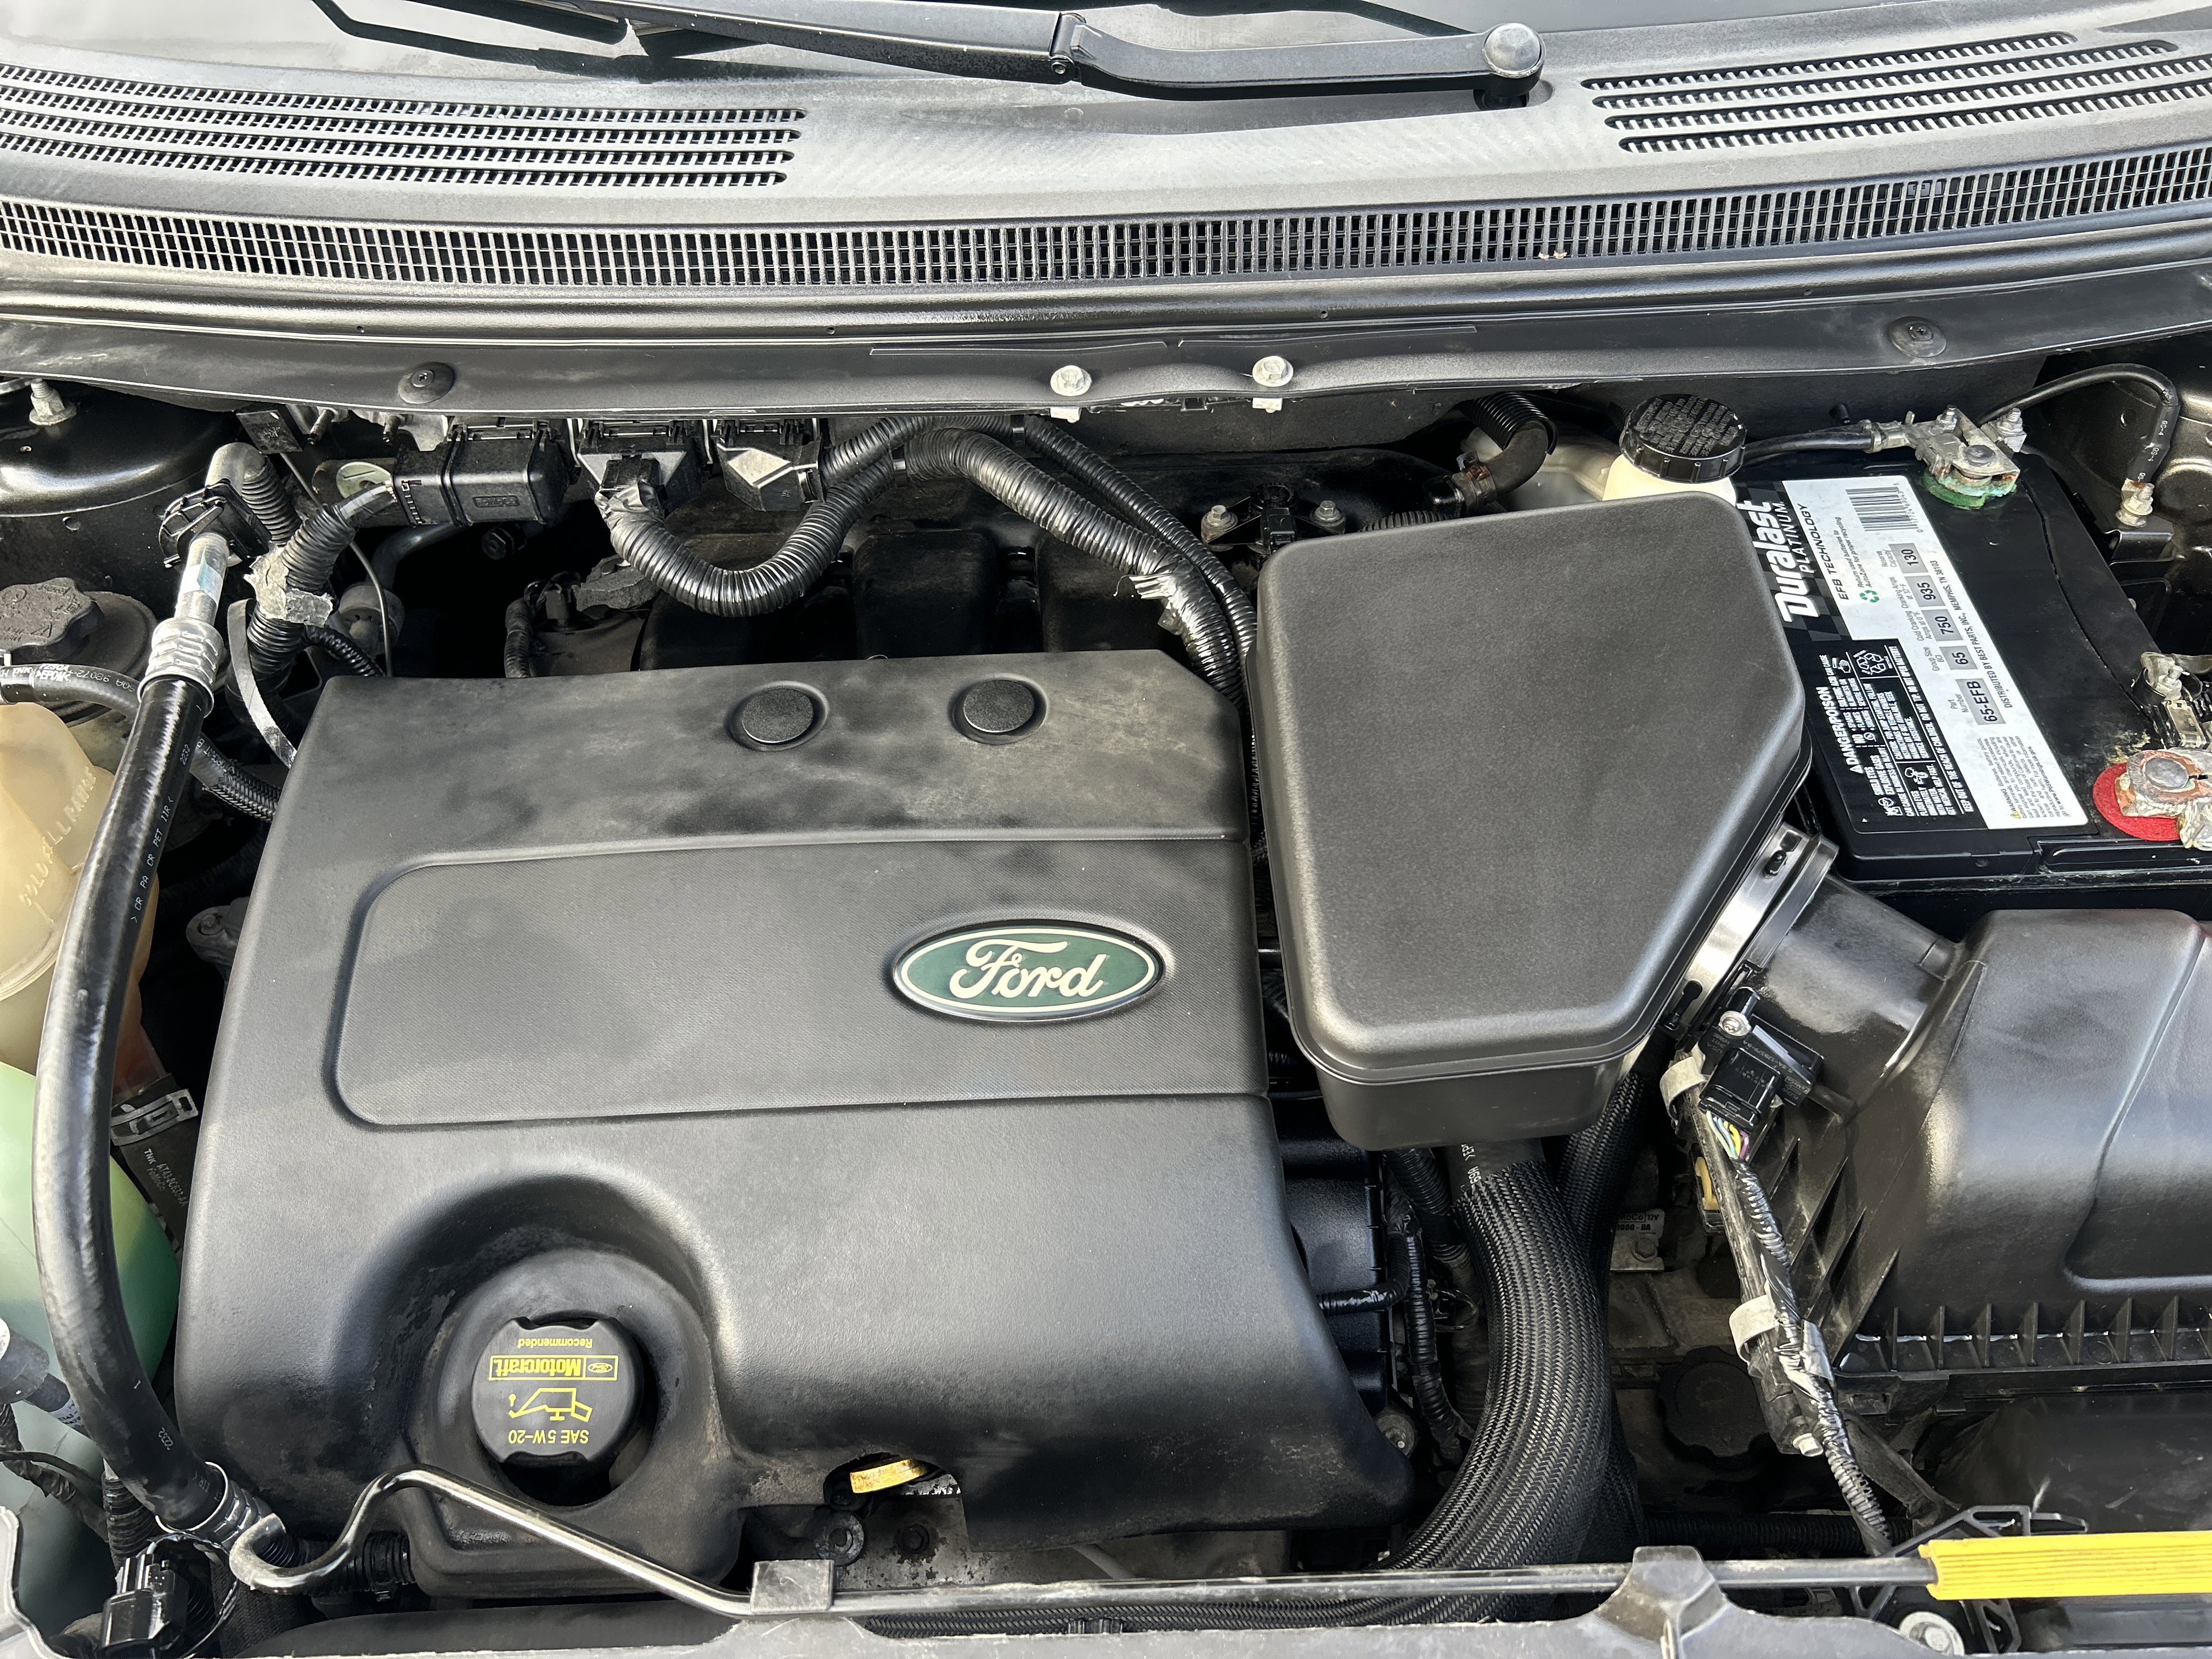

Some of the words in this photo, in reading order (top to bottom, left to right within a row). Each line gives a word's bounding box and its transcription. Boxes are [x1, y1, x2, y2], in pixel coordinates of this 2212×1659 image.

[1833, 516, 1850, 538] recycling
[1772, 503, 1814, 573] PLATINUM
[1797, 503, 1837, 574] TECHNOLOGY
[1835, 535, 1850, 557] batteries
[1844, 538, 1858, 555] proper
[1736, 499, 1819, 622] Duralast
[1844, 557, 1856, 569] used
[1875, 551, 1889, 567] Reserve
[1882, 549, 1899, 567] Capacity
[1899, 549, 1920, 566] 130
[1855, 563, 1872, 587] AutoZone
[1928, 560, 1943, 575] 38103
[1850, 571, 1864, 587] Return
[1887, 577, 1900, 589] Amps
[1831, 578, 1849, 600] EFB
[1916, 582, 1937, 600] 935
[1942, 584, 1962, 610] MEMPHIS,
[1893, 590, 1910, 608] Cranking
[1903, 611, 1921, 629] Cranking
[1933, 616, 1955, 634] 750
[1914, 631, 1925, 641] Cold
[1920, 626, 1934, 639] Amps
[1963, 626, 1981, 645] PARTS,
[1921, 647, 1933, 656] Size
[1950, 652, 1969, 664] 65
[1973, 646, 1988, 659] BEST
[1926, 657, 1940, 670] Group
[1986, 670, 2013, 707] DISTRIBUTED
[1915, 703, 1928, 713] NOT
[1946, 699, 1959, 709] Part
[1953, 693, 1969, 712] Number
[1965, 680, 1999, 721] 65-EFB
[1815, 686, 1860, 765] DANGER/POISON
[1850, 733, 1866, 743] NO
[1869, 755, 1884, 769] GASES
[1938, 754, 1954, 770] REACH
[1876, 770, 1895, 794] EXPLOSIVE
[1946, 770, 1959, 780] THE
[1954, 788, 1968, 799] OUT
[1959, 799, 1974, 811] KEEP
[140, 875, 149, 889] PA
[153, 828, 163, 847] PET
[950, 939, 1107, 998] Ford
[144, 1148, 156, 1165] TNK
[518, 1338, 592, 1348] Recommended
[494, 1358, 582, 1376] Motorcraft
[509, 1430, 555, 1444] 5W-20
[561, 1430, 589, 1444] SAE
